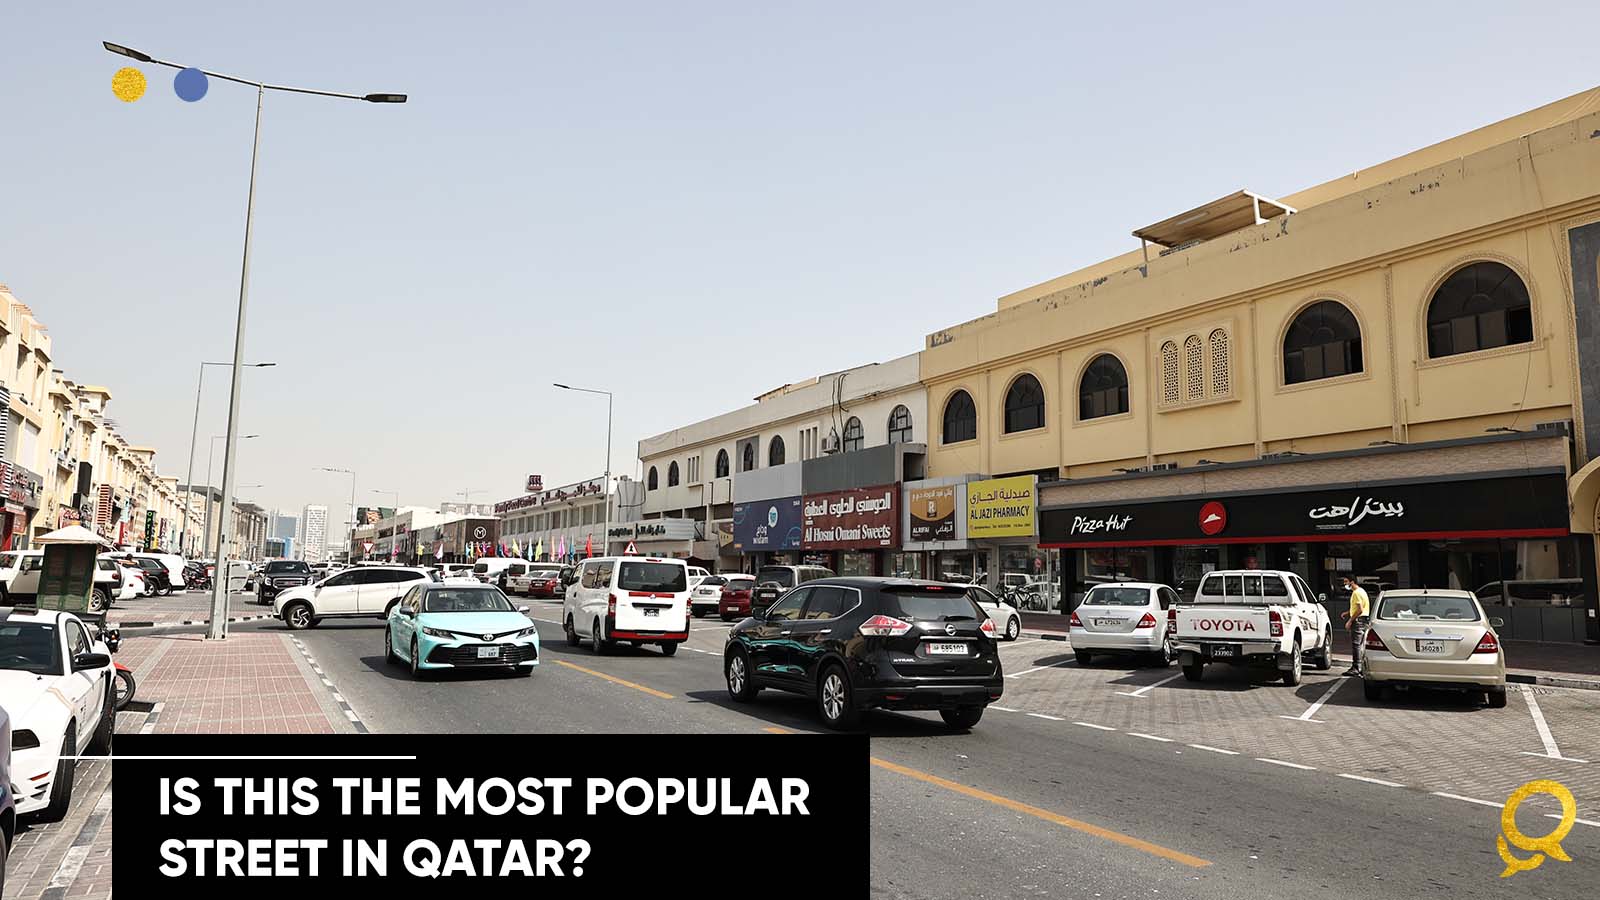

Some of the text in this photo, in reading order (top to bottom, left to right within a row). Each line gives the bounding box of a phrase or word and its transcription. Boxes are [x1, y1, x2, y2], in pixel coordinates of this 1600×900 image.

[999, 488, 1030, 502] صيدلية
[970, 505, 1030, 520] AL JAZI PHARMACY
[144, 510, 154, 548] OPTICS
[803, 527, 813, 542] Al
[813, 526, 835, 542] Hosni
[835, 524, 861, 541] Omani
[861, 523, 891, 540] Sweets
[1070, 513, 1133, 535] Pizza Hut
[1190, 619, 1256, 632] TOYOTA
